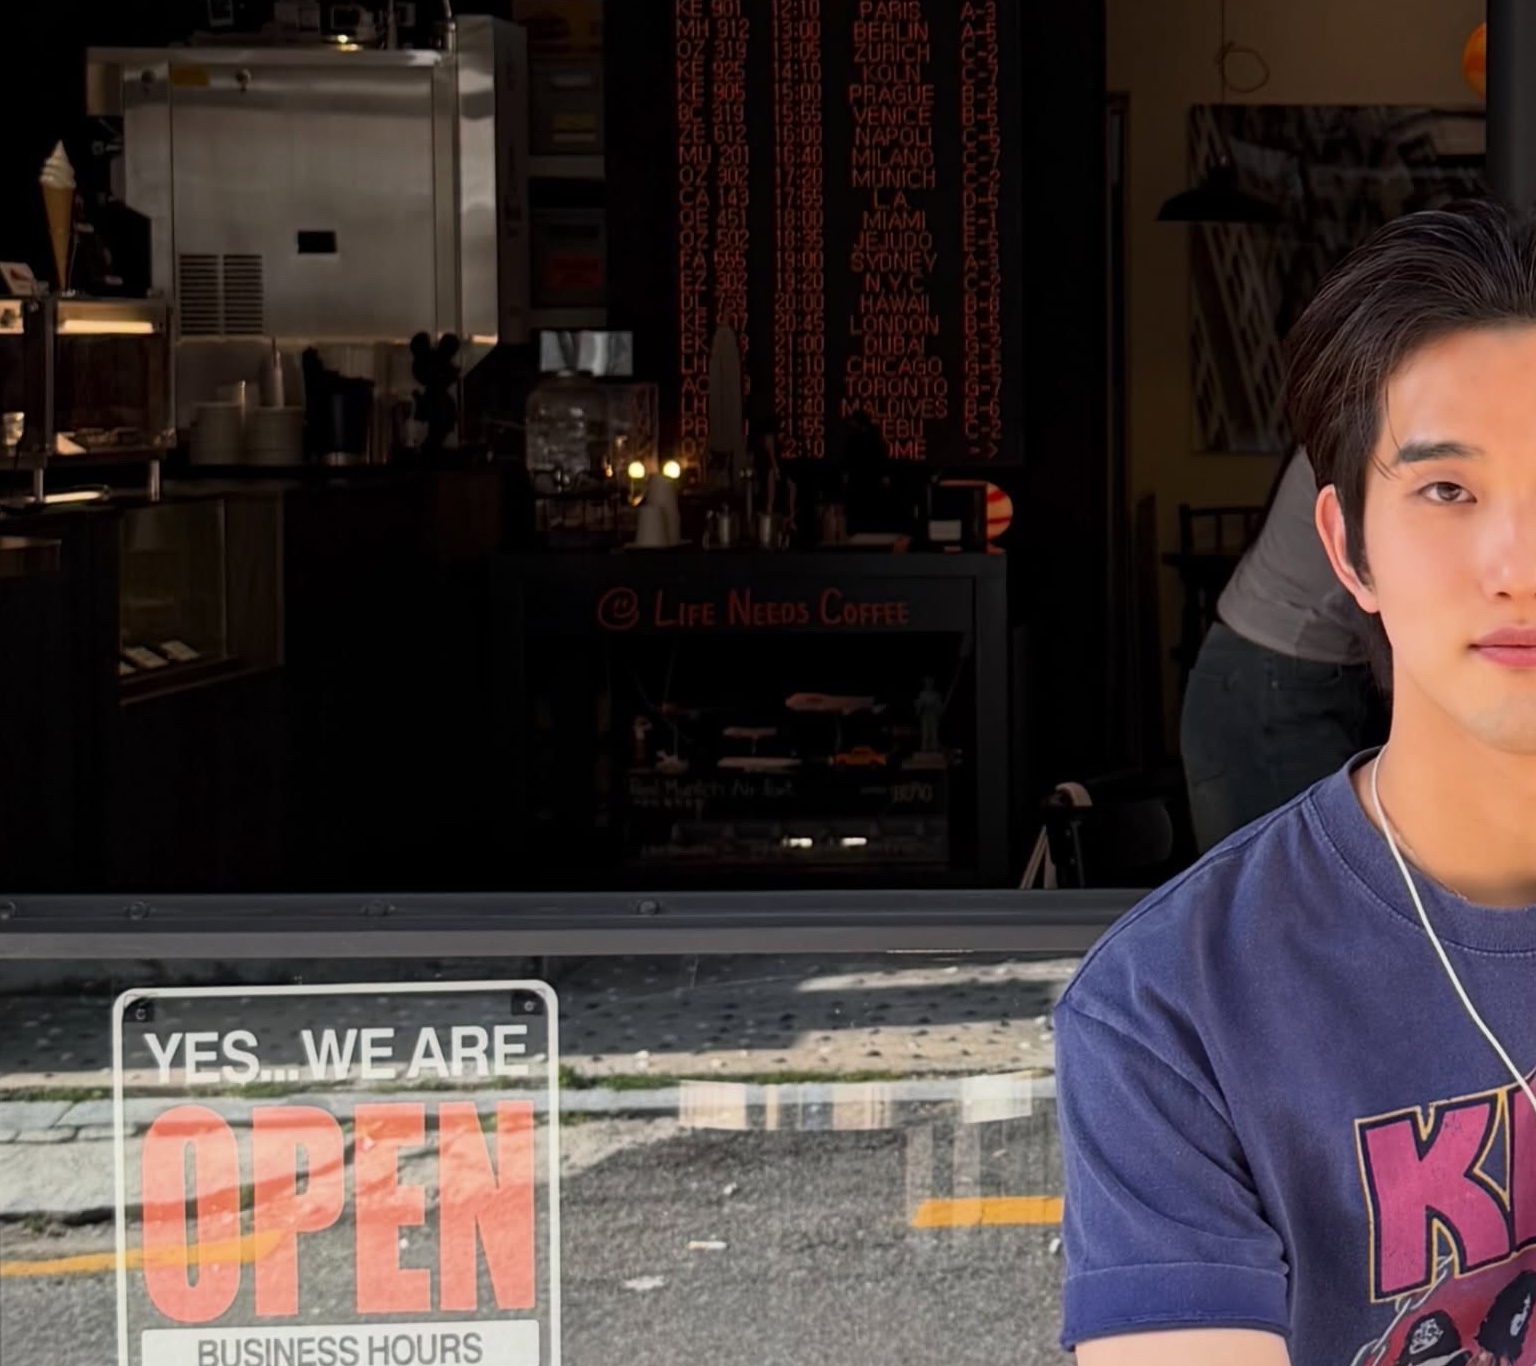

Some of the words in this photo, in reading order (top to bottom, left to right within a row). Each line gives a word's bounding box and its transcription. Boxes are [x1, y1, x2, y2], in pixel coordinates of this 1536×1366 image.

[771, 0, 820, 16] 12:10
[858, 1, 919, 18] PARIS
[772, 20, 820, 37] 13:00
[852, 22, 928, 39] BERLIN
[773, 41, 820, 58] 13:05
[853, 43, 932, 60] ZURICH
[772, 62, 822, 79] 14:10
[772, 83, 821, 100] 15:00
[846, 85, 932, 102] PRAGUE
[854, 106, 930, 123] VENICE
[774, 125, 822, 142] 16:00
[853, 127, 932, 144] NAPOLI
[774, 146, 821, 163] 16:40
[849, 148, 933, 165] MILANO
[774, 167, 822, 184] 17:20
[849, 169, 936, 186] MUNICH
[862, 211, 925, 228] MIAMI
[853, 232, 932, 249] JEJUDO
[776, 251, 823, 268] 19:00
[850, 253, 937, 270] SYDNEY
[776, 272, 823, 289] 19:20
[773, 294, 824, 311] 20:00
[858, 295, 928, 312] HAWAII
[773, 315, 822, 332] 20:45
[851, 316, 940, 333] LONDON
[774, 336, 824, 353] 21:00
[862, 337, 925, 354] DUBAI
[772, 357, 824, 374] 21:10
[846, 358, 942, 375] CHICAGO
[773, 378, 824, 395] 21:20
[846, 379, 947, 396] TORONTO
[775, 399, 824, 416] 21:40
[838, 400, 948, 417] MALDIVES
[883, 421, 924, 438] EBU
[302, 1028, 396, 1081] WE
[408, 1024, 529, 1079] ARE
[142, 1099, 535, 1323] OPEN
[368, 1332, 482, 1366] HOURS
